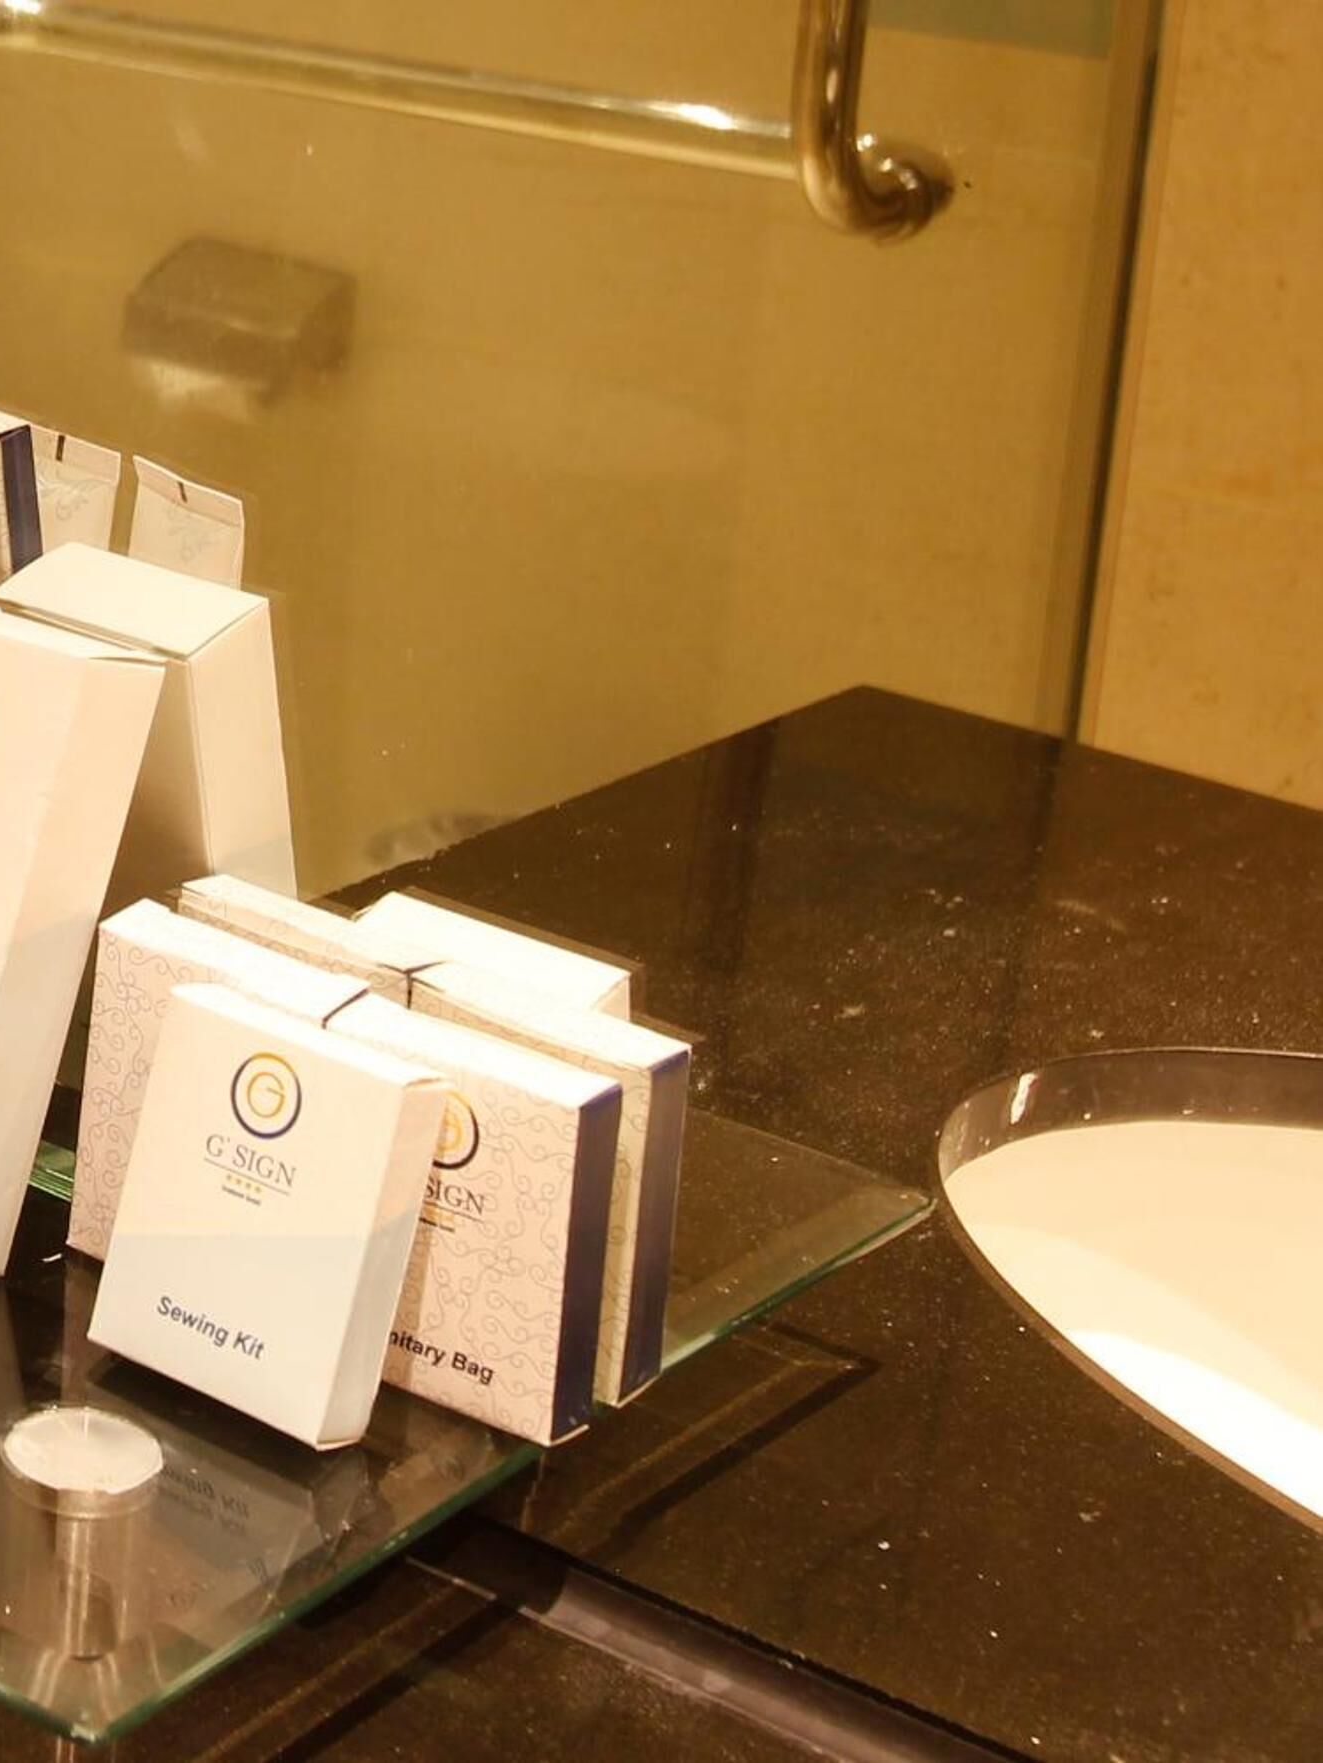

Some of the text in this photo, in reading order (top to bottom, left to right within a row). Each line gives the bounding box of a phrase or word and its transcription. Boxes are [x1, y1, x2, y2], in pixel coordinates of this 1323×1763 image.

[156, 1295, 265, 1361] Sewing Kit
[451, 1351, 495, 1386] Bag
